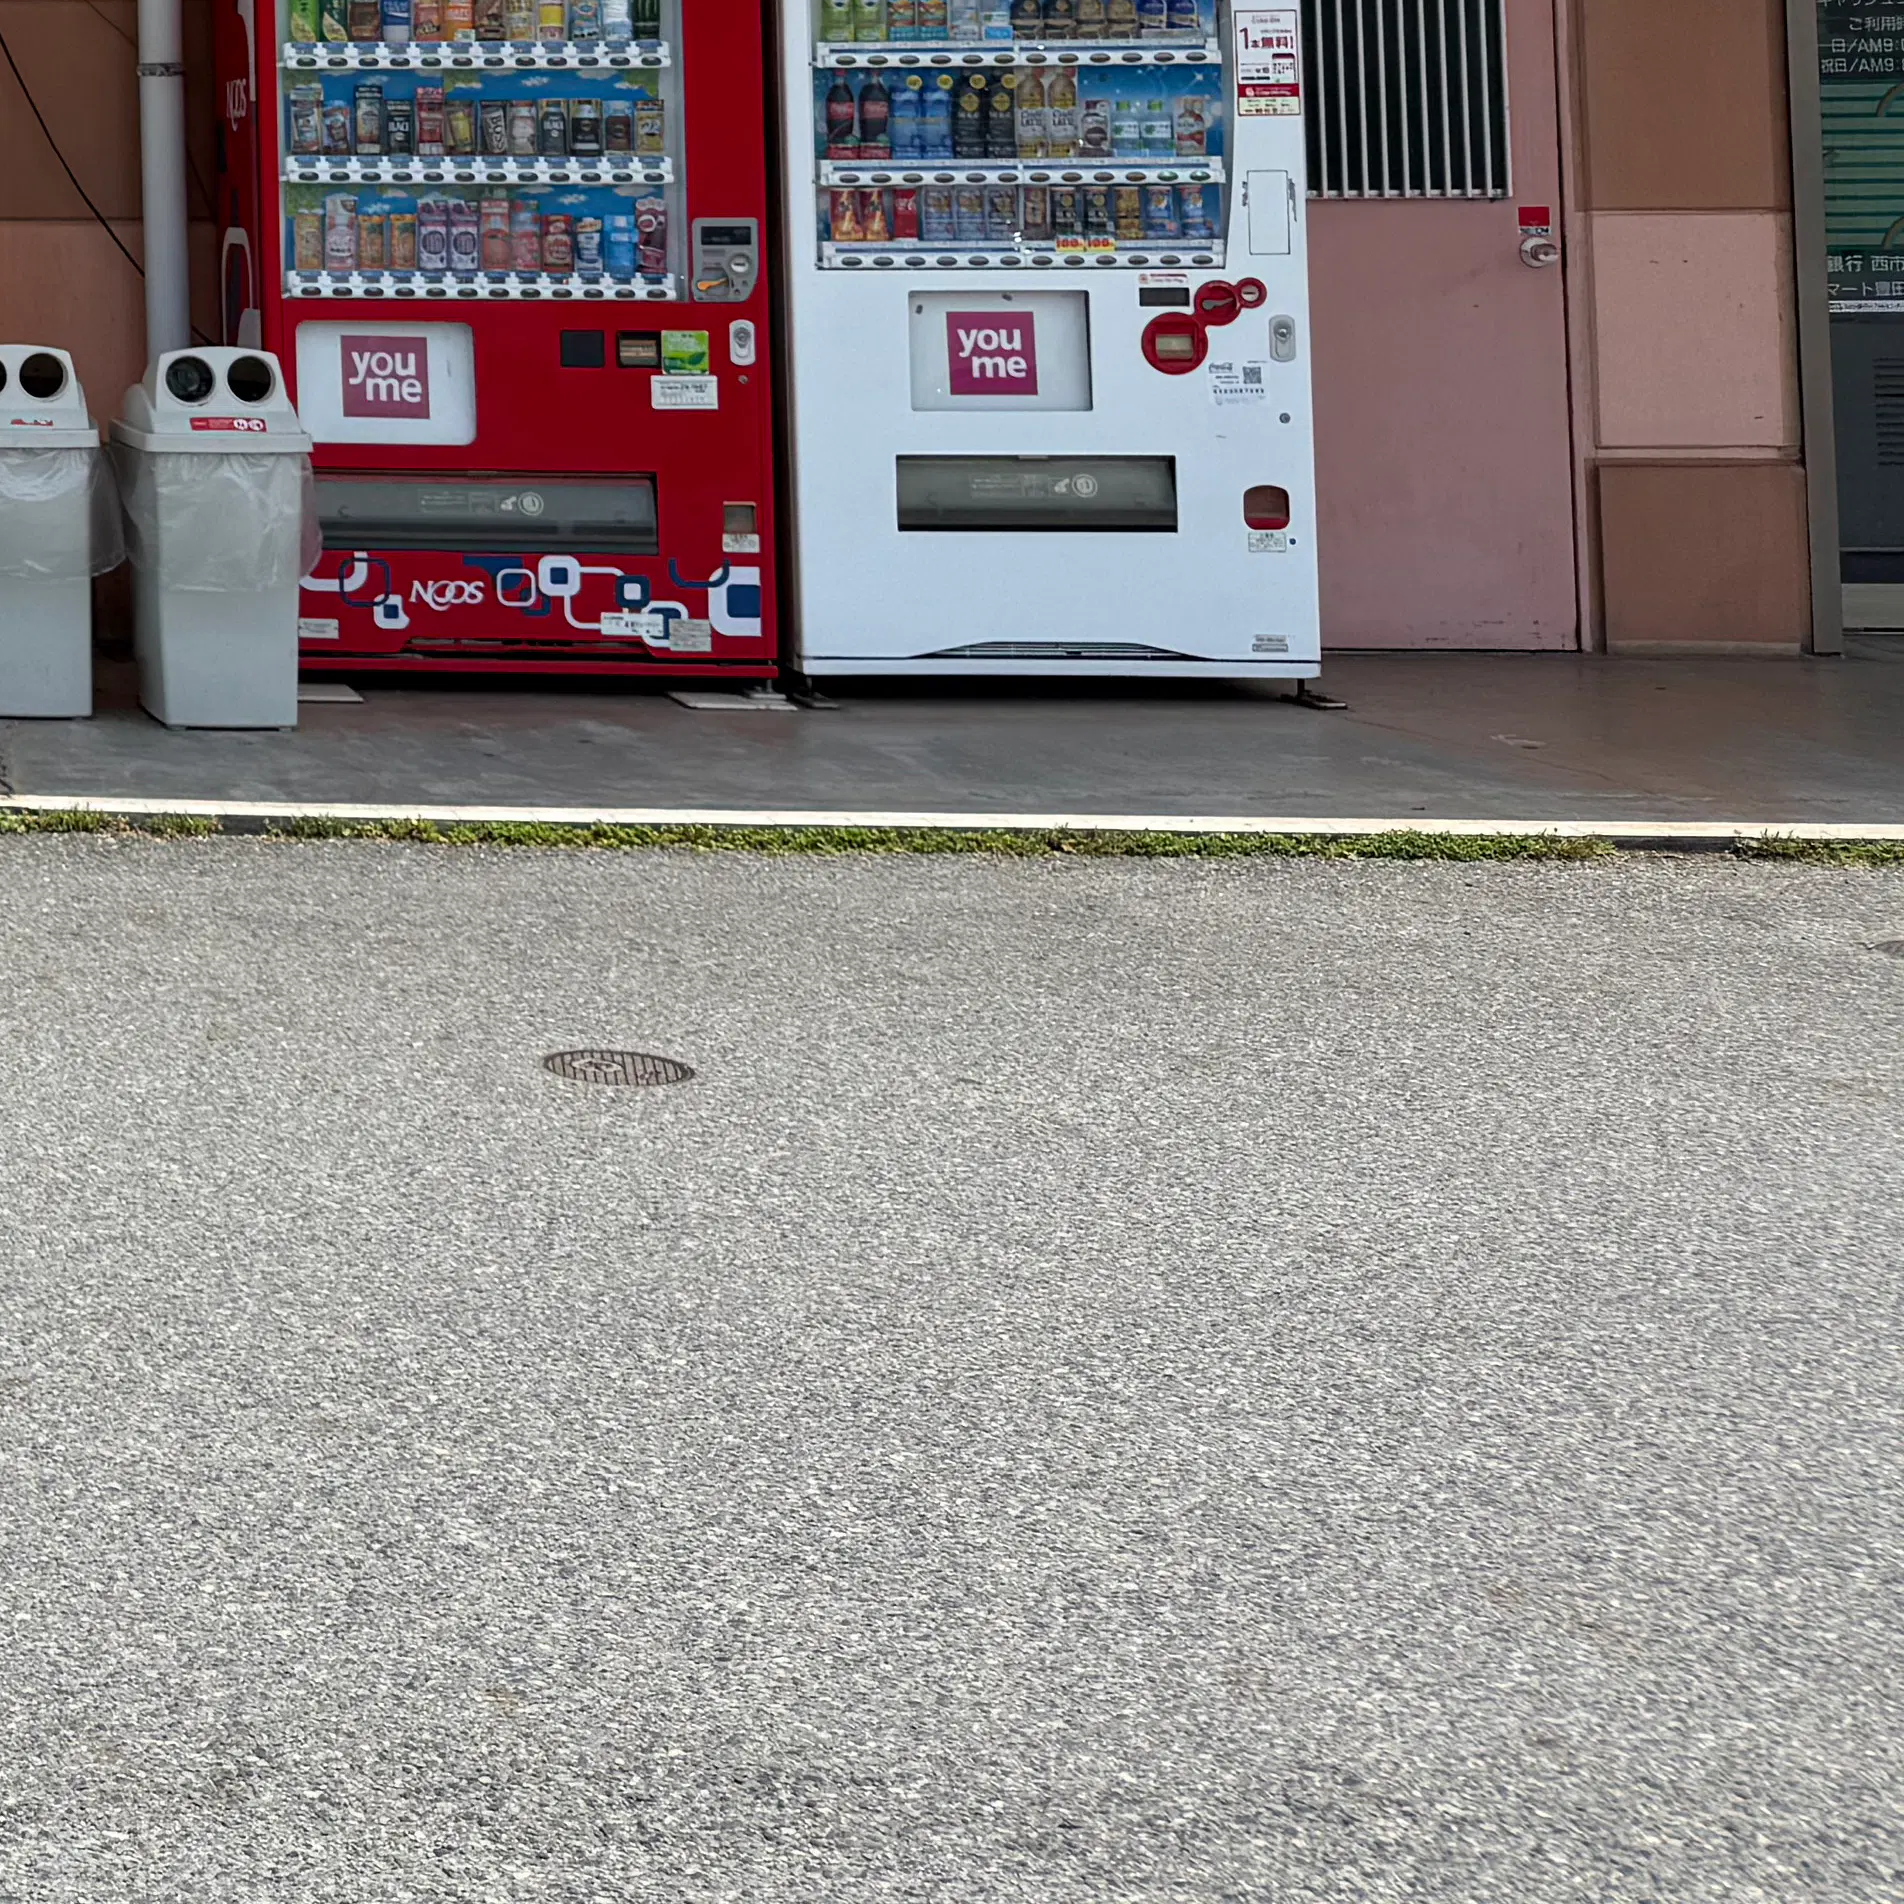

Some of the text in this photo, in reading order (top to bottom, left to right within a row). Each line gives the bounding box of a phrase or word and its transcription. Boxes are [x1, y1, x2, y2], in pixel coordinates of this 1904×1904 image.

[957, 328, 1022, 358] you
[349, 351, 417, 385] you
[971, 355, 1028, 379] me
[366, 377, 423, 403] me
